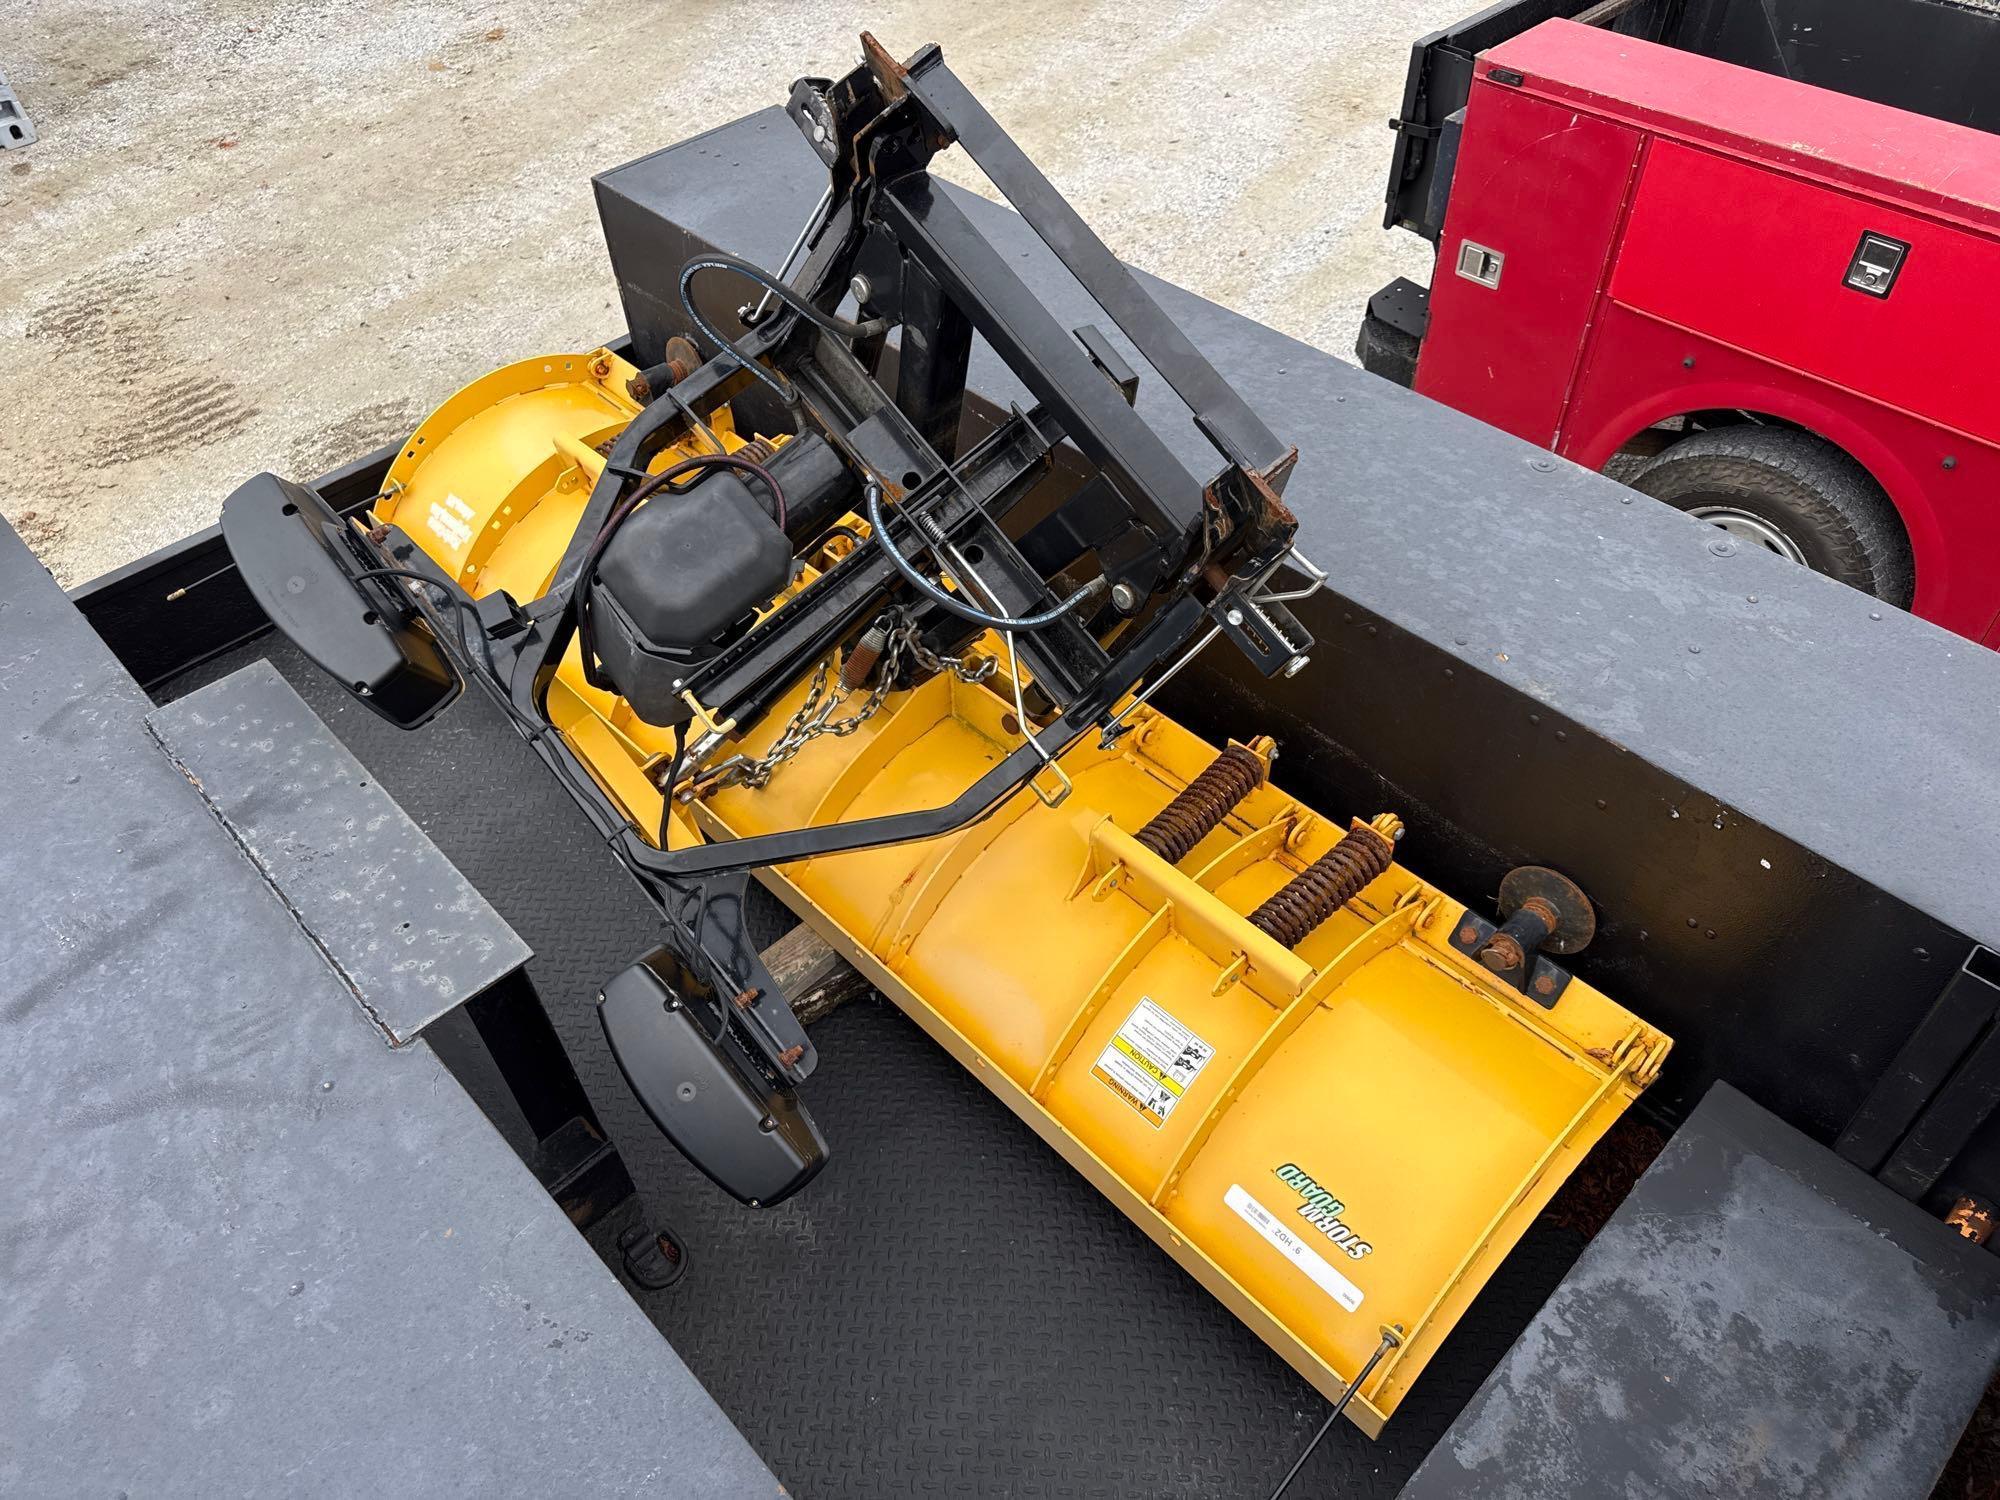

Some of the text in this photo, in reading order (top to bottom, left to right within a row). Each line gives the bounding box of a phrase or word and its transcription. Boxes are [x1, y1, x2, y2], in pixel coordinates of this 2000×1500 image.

[1129, 1049, 1158, 1075] CAUTION
[1108, 1077, 1142, 1106] WARNING
[1275, 1162, 1346, 1217] GUARD
[1296, 1203, 1373, 1260] STORM
